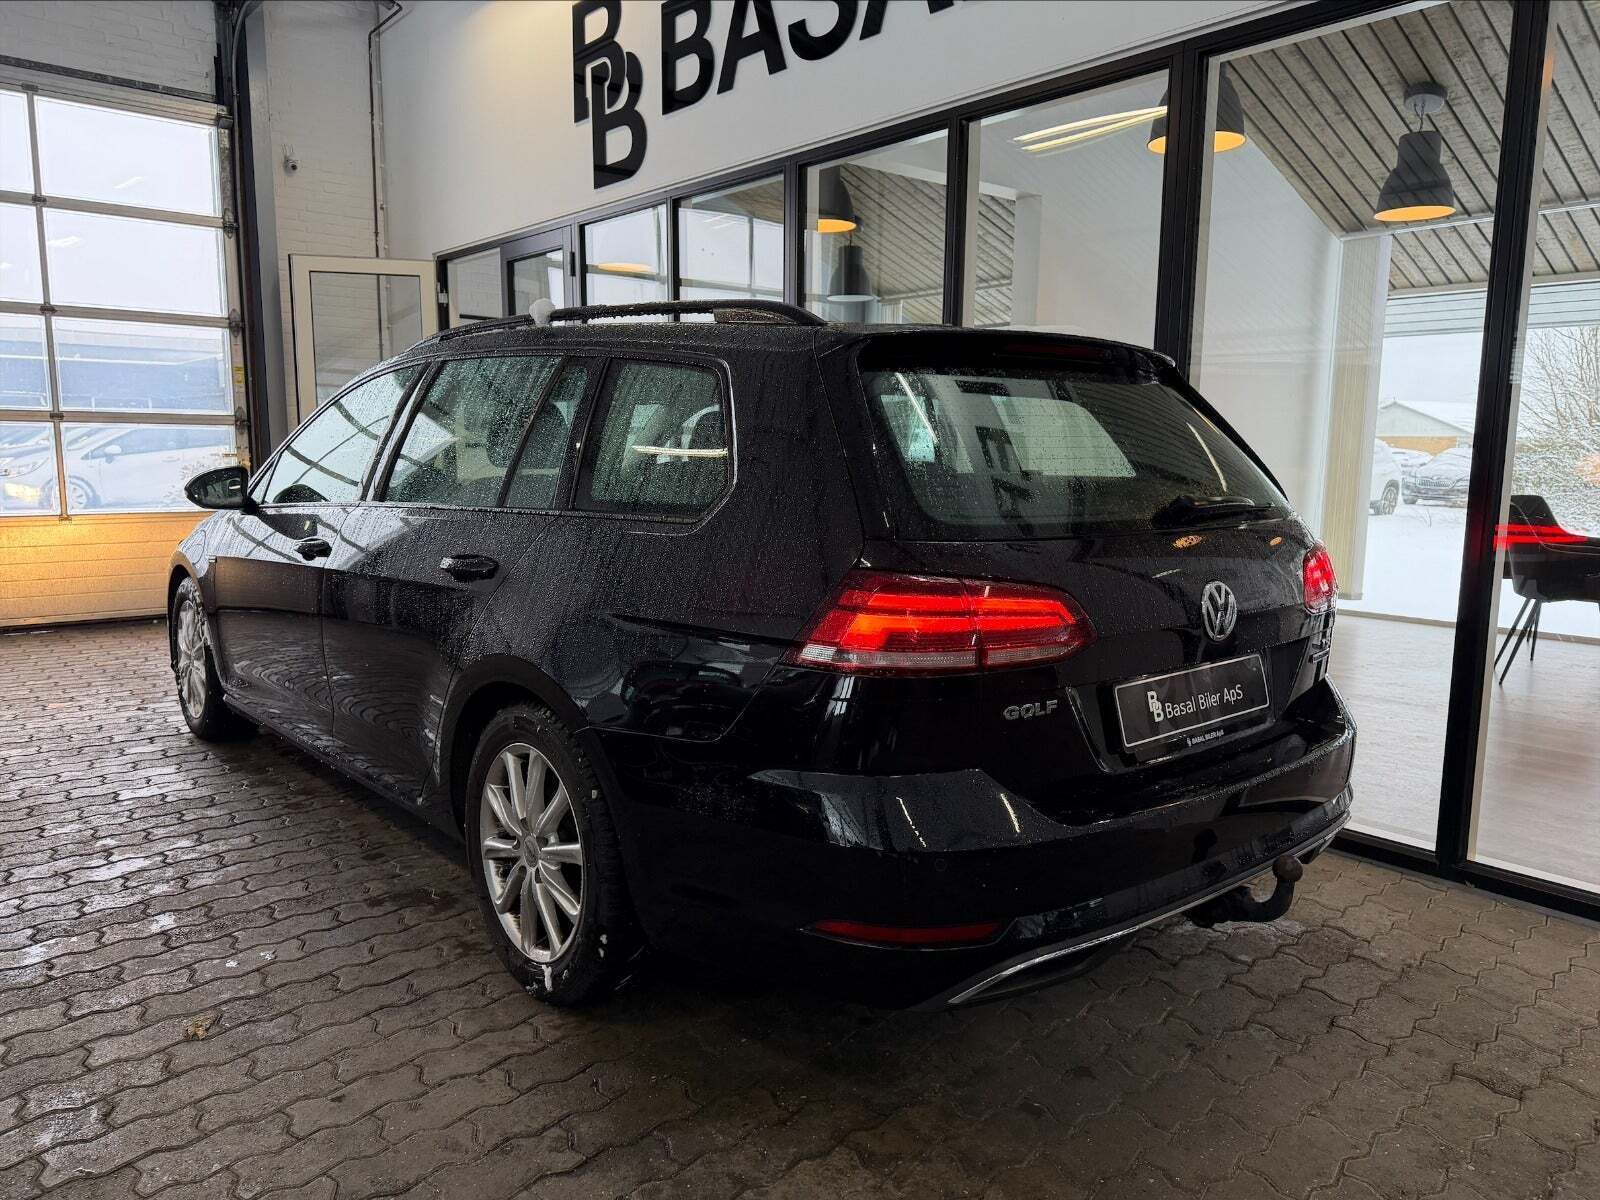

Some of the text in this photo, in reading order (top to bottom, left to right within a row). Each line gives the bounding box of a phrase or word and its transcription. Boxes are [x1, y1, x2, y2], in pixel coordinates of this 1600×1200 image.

[1002, 699, 1058, 720] GOLF
[1165, 696, 1197, 718] Basal
[1198, 692, 1221, 709] Biler
[1224, 684, 1243, 704] ApS
